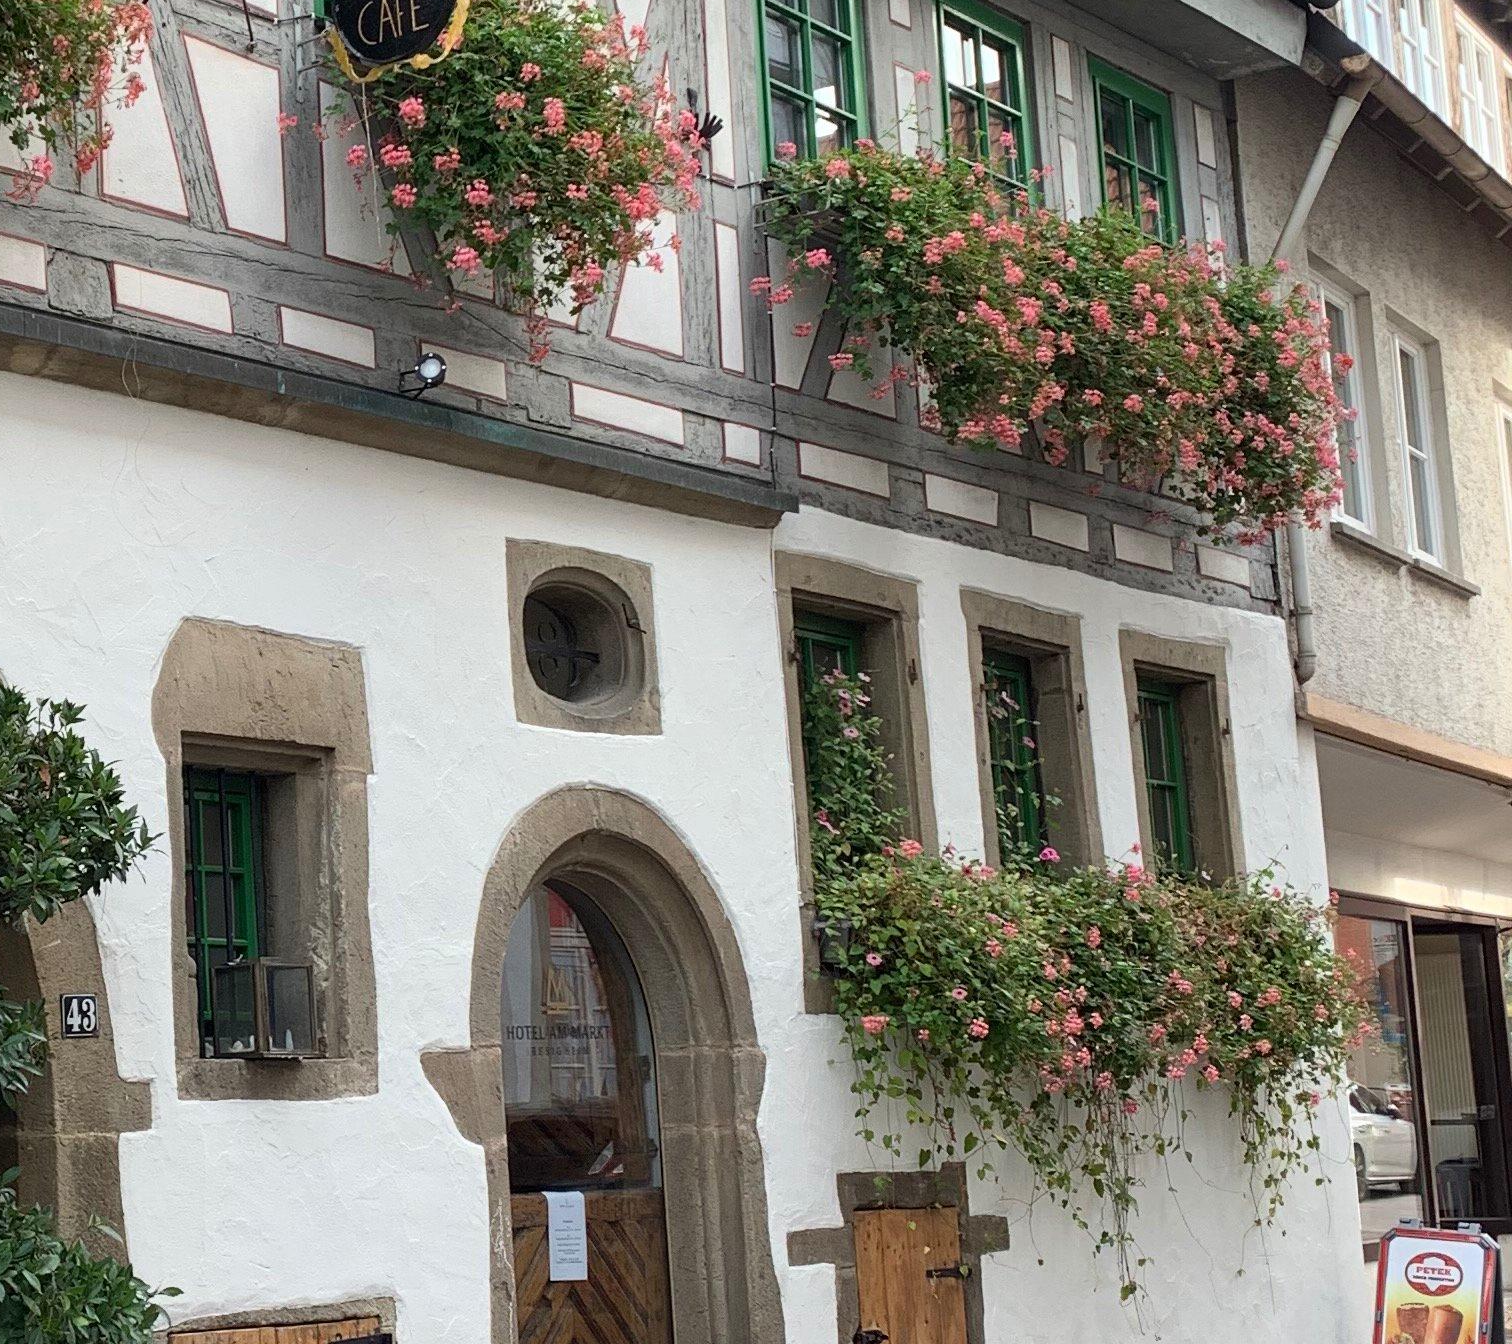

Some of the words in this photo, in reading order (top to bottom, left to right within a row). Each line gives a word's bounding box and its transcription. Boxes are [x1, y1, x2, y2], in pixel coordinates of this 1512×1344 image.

[66, 998, 96, 1032] 43
[506, 1025, 545, 1040] HOTEL
[569, 1025, 610, 1040] MARKT
[1416, 1266, 1452, 1276] PETEK
